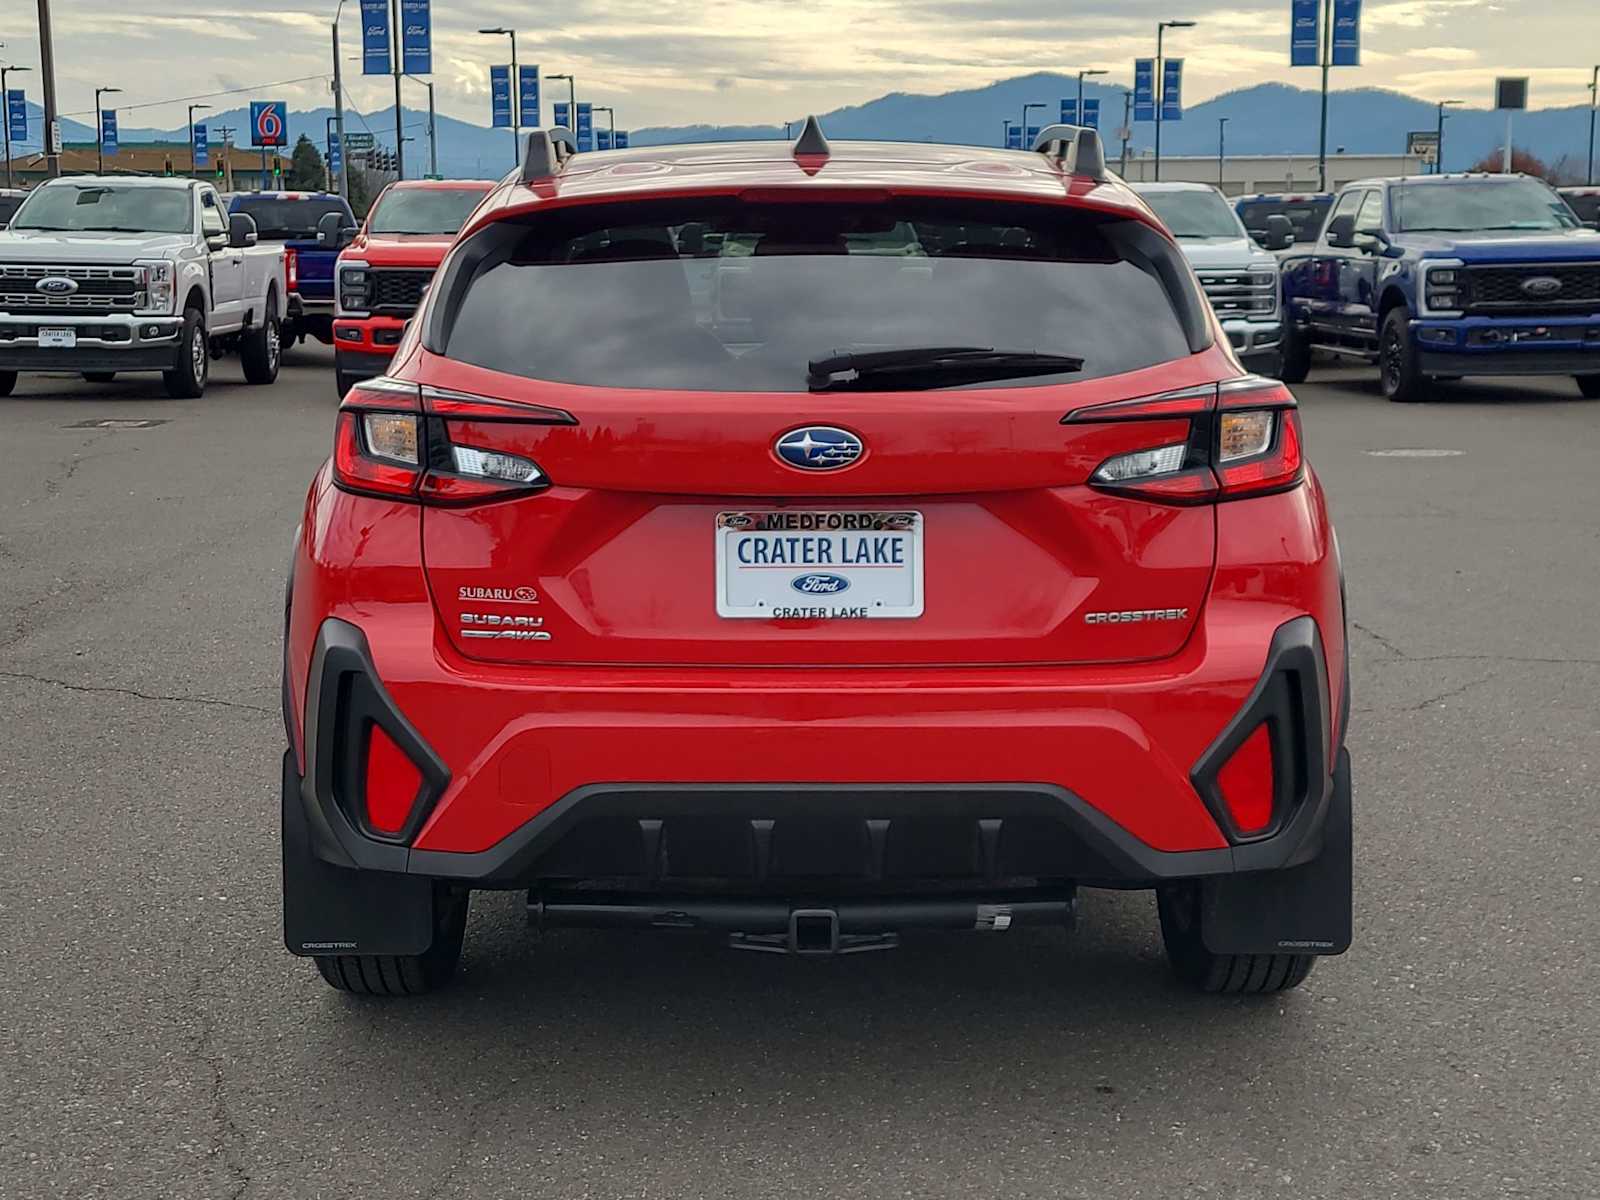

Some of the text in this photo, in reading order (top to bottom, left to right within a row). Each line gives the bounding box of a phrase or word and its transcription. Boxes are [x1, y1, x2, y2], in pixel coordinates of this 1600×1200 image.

[367, 26, 386, 36] Ford
[406, 25, 426, 36] Ford
[257, 104, 282, 137] 6
[767, 514, 873, 529] MEDFORD
[737, 537, 904, 564] CRATER LAKE
[802, 576, 839, 592] Ford
[459, 586, 513, 600] SUBARU
[772, 607, 868, 618] CRATER LAKE
[1084, 608, 1188, 624] CROSSTREK
[460, 613, 544, 627] SUBARU
